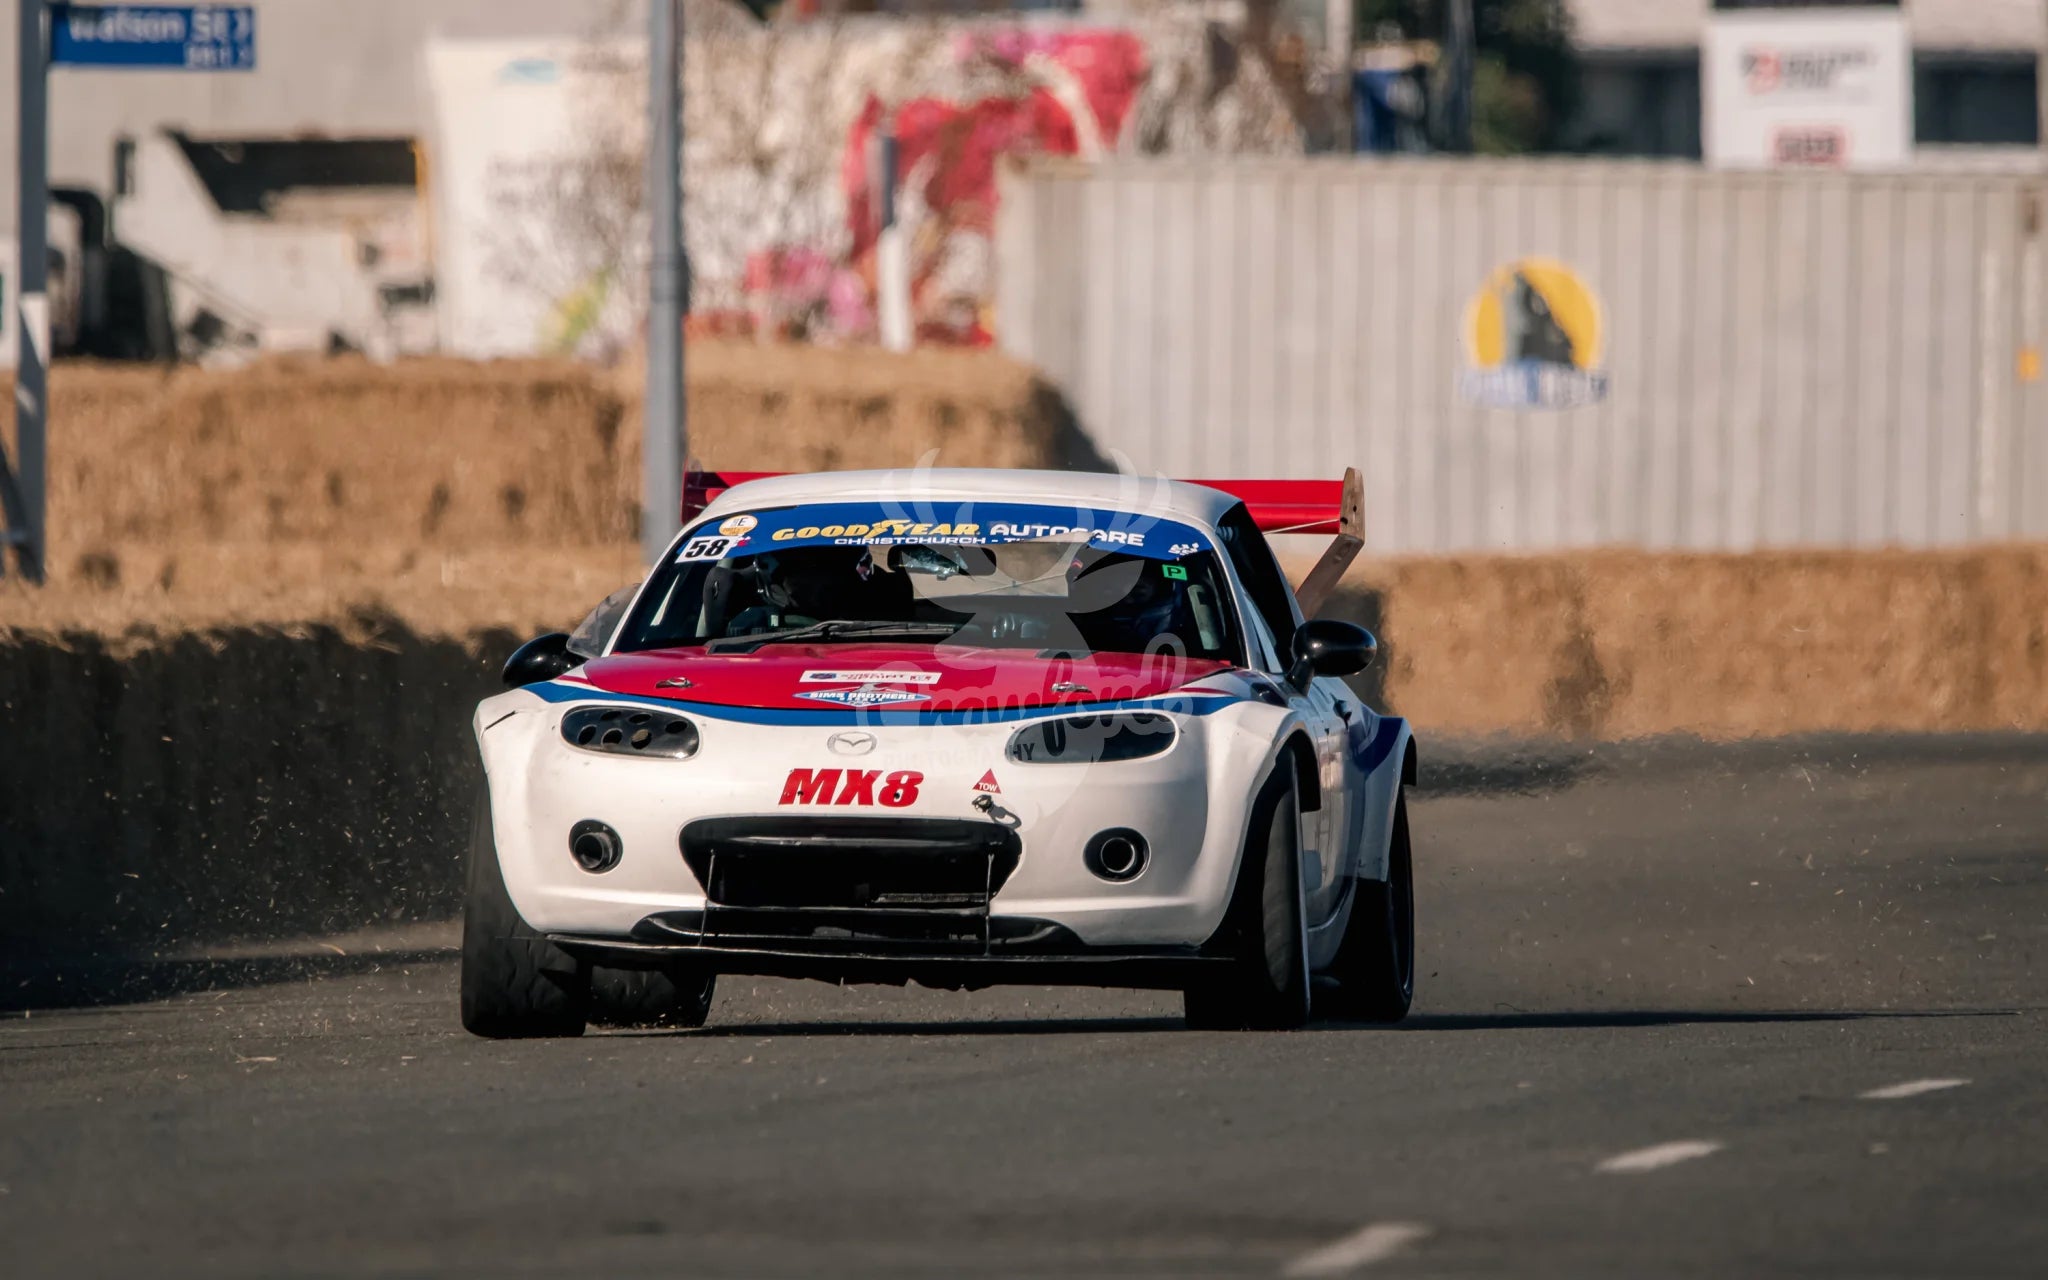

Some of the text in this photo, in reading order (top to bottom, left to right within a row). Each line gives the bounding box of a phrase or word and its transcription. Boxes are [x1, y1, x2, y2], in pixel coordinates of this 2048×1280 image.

[771, 519, 1145, 547] GOODYEAR AUTOARE
[834, 537, 986, 545] CHRISTCHURCH
[684, 539, 731, 558] 58
[778, 768, 924, 808] MX8
[977, 781, 998, 792] TOW
